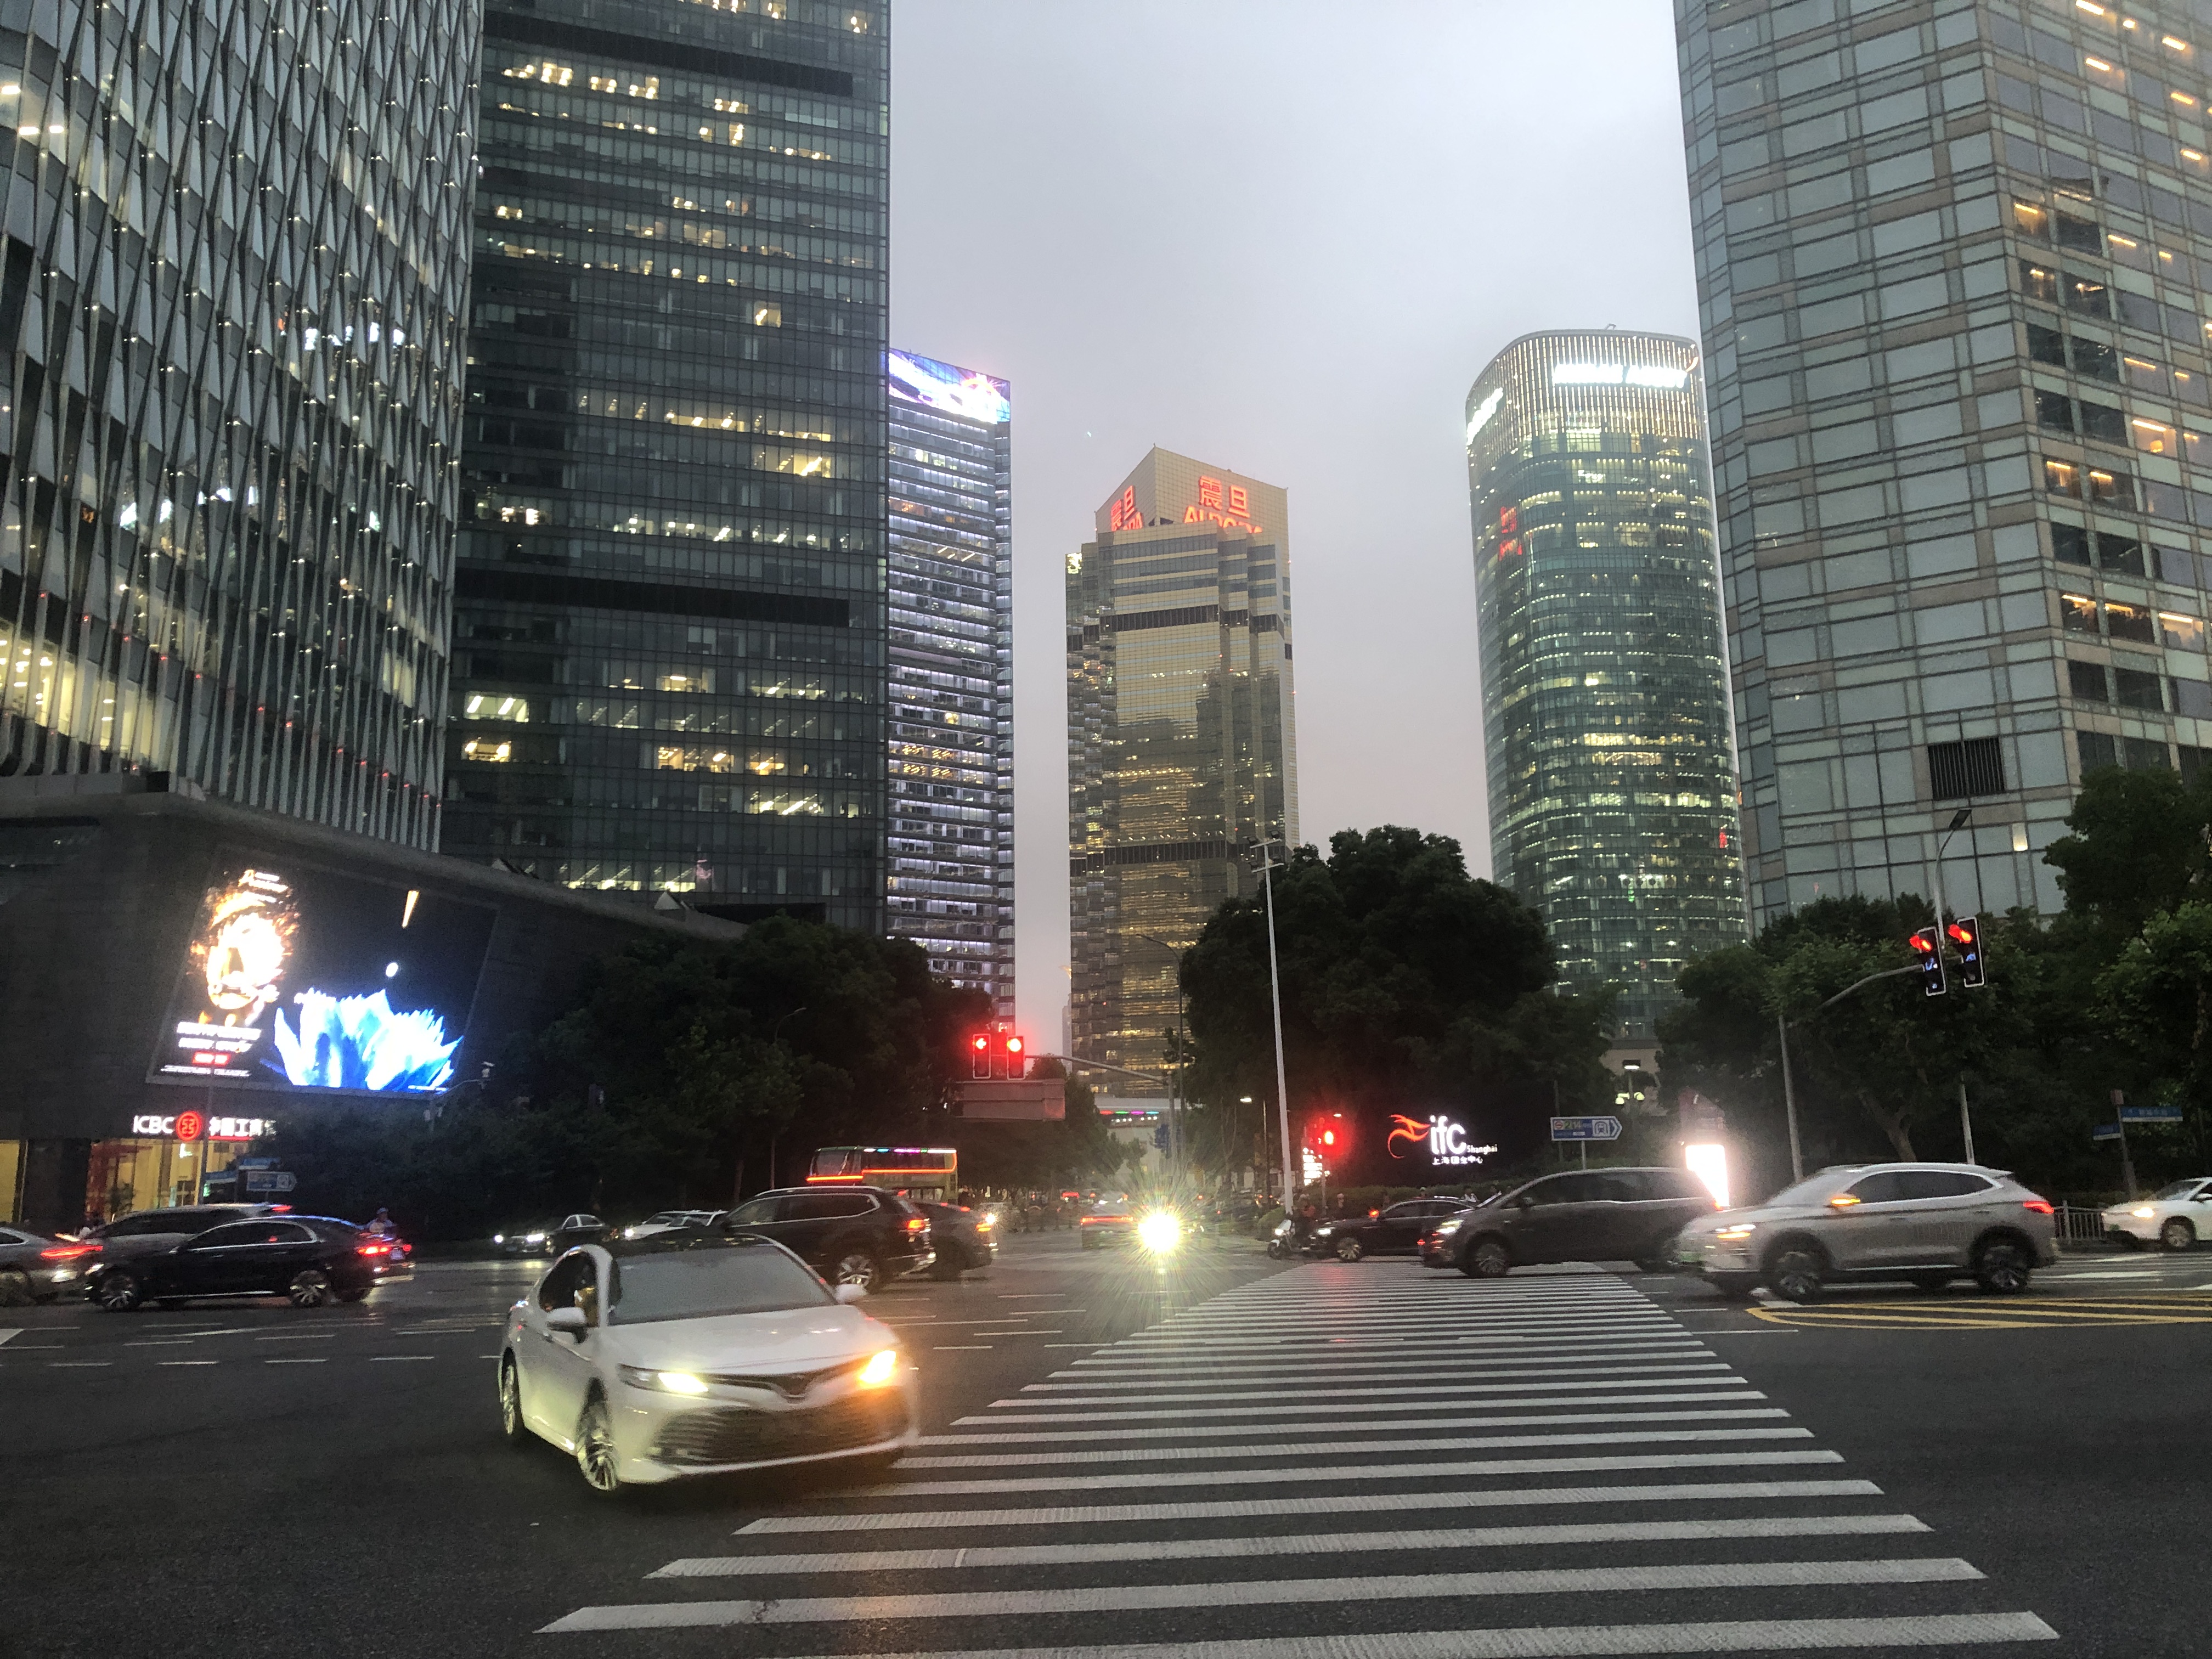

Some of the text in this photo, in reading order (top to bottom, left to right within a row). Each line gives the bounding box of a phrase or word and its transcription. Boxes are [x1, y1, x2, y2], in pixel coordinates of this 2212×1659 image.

[1111, 485, 1135, 532] 震旦
[1199, 476, 1250, 518] 震旦
[133, 1115, 174, 1134] ICBC
[1430, 1115, 1498, 1155] ifc Shanghai
